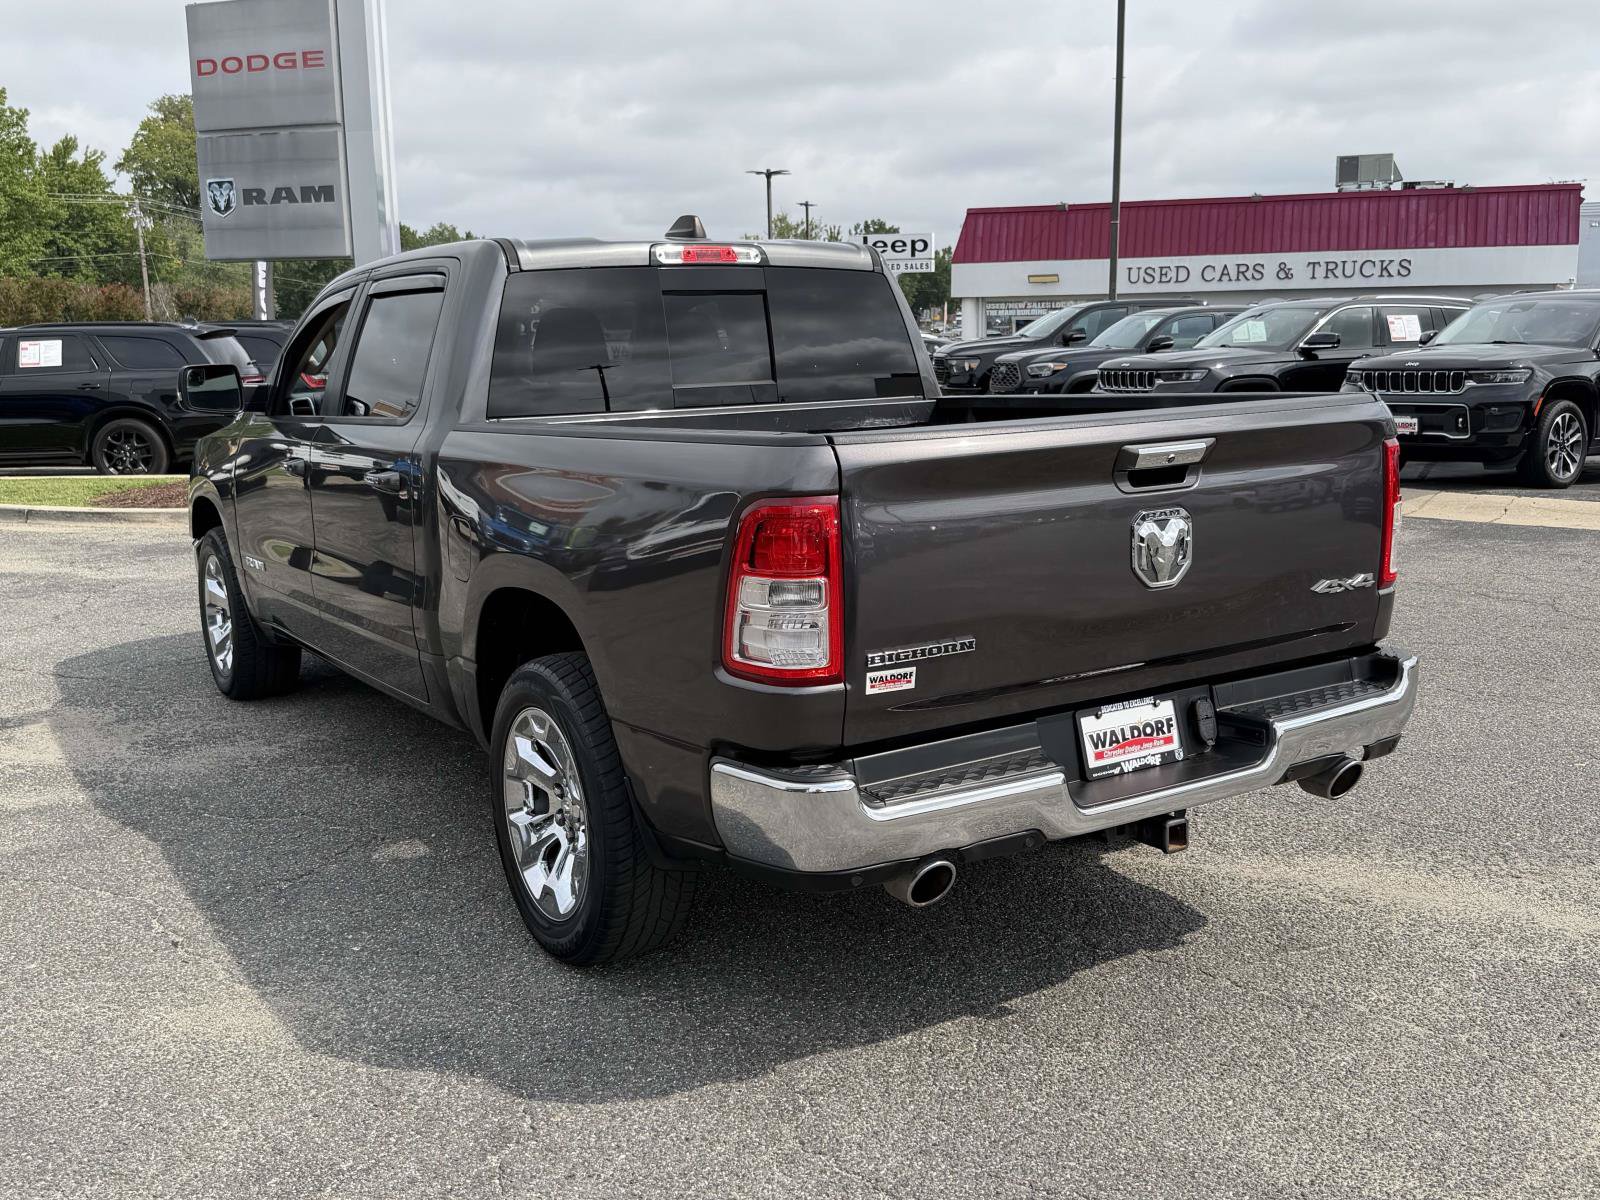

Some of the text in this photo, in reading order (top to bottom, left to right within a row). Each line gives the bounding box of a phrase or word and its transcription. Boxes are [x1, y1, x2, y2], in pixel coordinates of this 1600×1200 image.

[196, 50, 326, 77] DODGE
[242, 184, 336, 206] RAM
[904, 262, 930, 270] SALES
[1127, 258, 1412, 284] USED CARS & TRUCKS
[867, 638, 976, 668] BIGHORN
[869, 671, 914, 684] WALDORF
[1101, 702, 1124, 714] DEDICATED
[1123, 700, 1130, 709] TO
[1088, 716, 1174, 751] WALDORF
[1120, 754, 1161, 773] WALDORF
